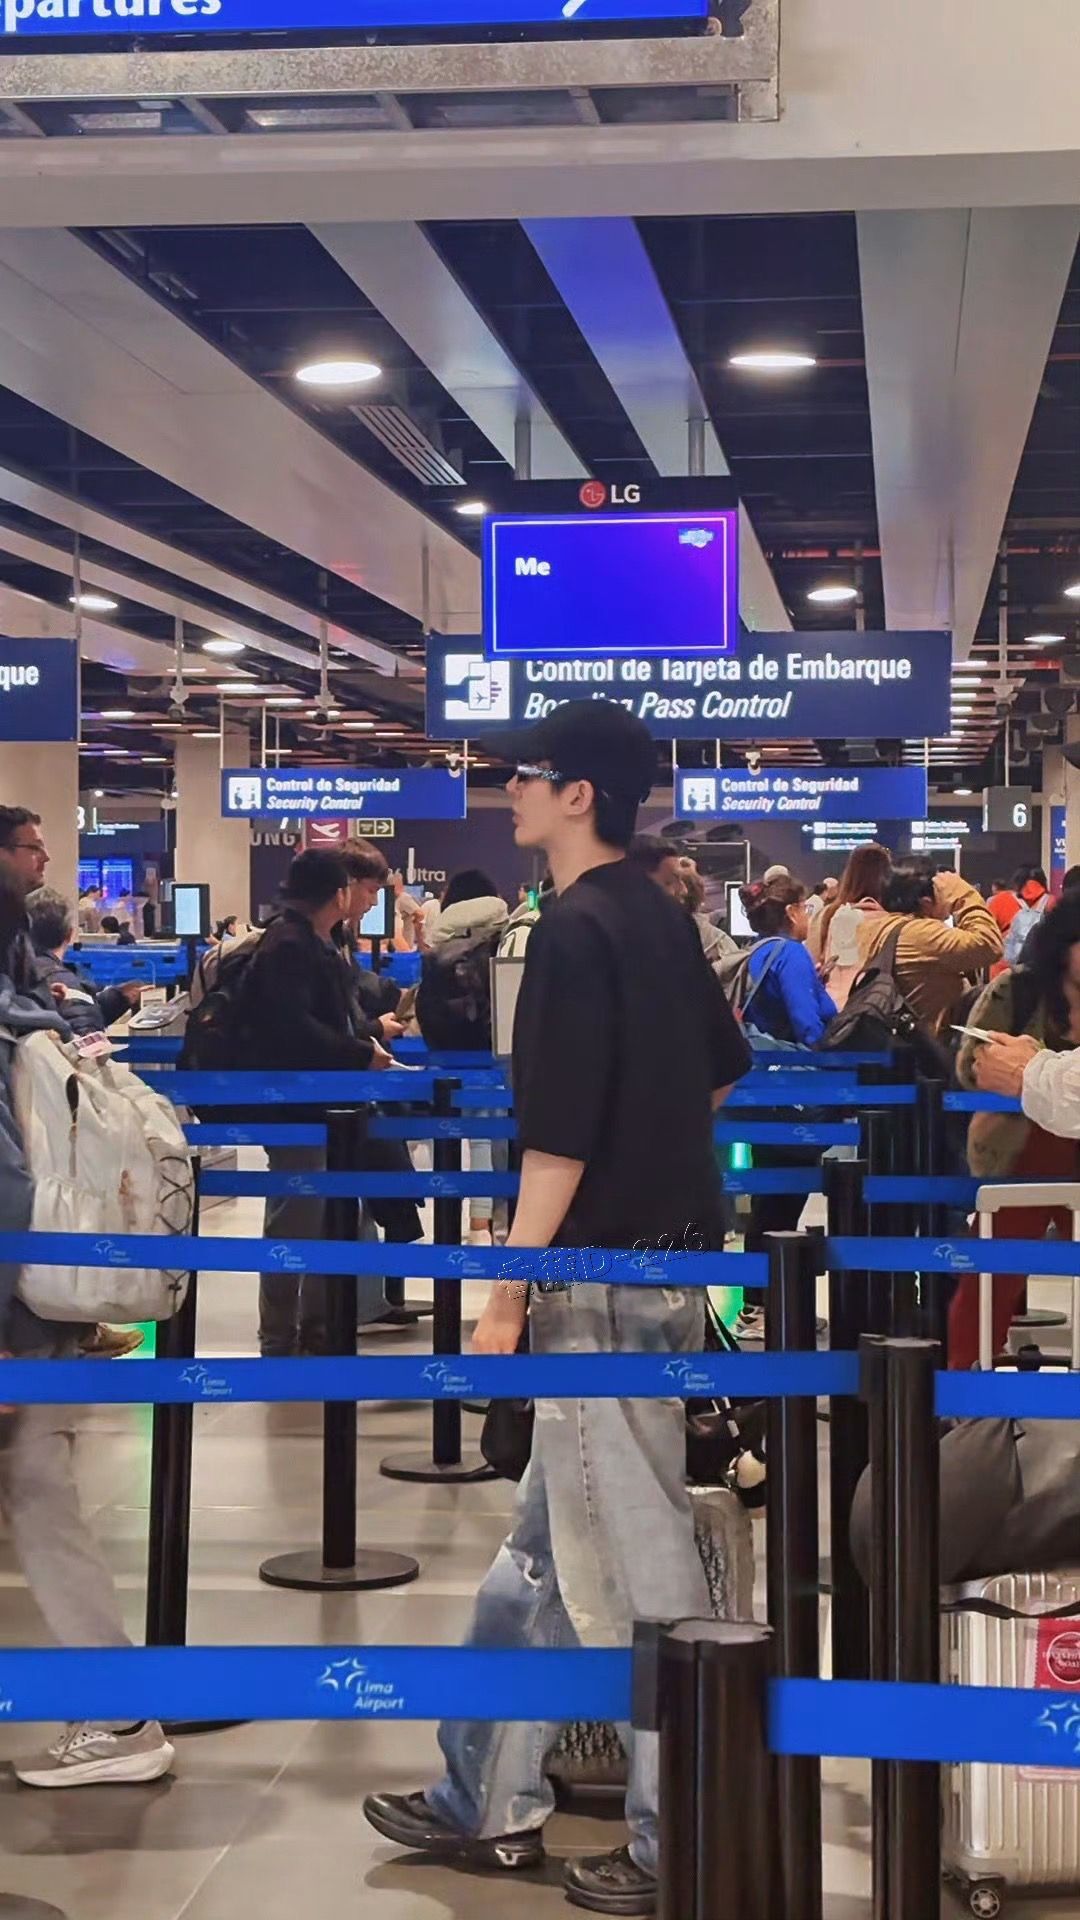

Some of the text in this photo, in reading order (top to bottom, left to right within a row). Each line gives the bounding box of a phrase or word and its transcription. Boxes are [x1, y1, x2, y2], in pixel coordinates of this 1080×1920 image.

[611, 484, 641, 503] LG
[514, 557, 551, 576] Me
[526, 658, 614, 682] Control
[621, 658, 651, 681] de
[749, 653, 779, 681] de
[786, 652, 912, 685] Embarque
[638, 691, 697, 719] Pass
[702, 690, 793, 719] Control
[266, 777, 400, 795] Control de Seguridad
[721, 776, 859, 795] Control de Seguridad
[266, 796, 364, 812] Security Control
[722, 796, 822, 813] Security Control
[1012, 803, 1027, 827] 6
[356, 1680, 394, 1694] Lima
[353, 1696, 404, 1713] Airport
